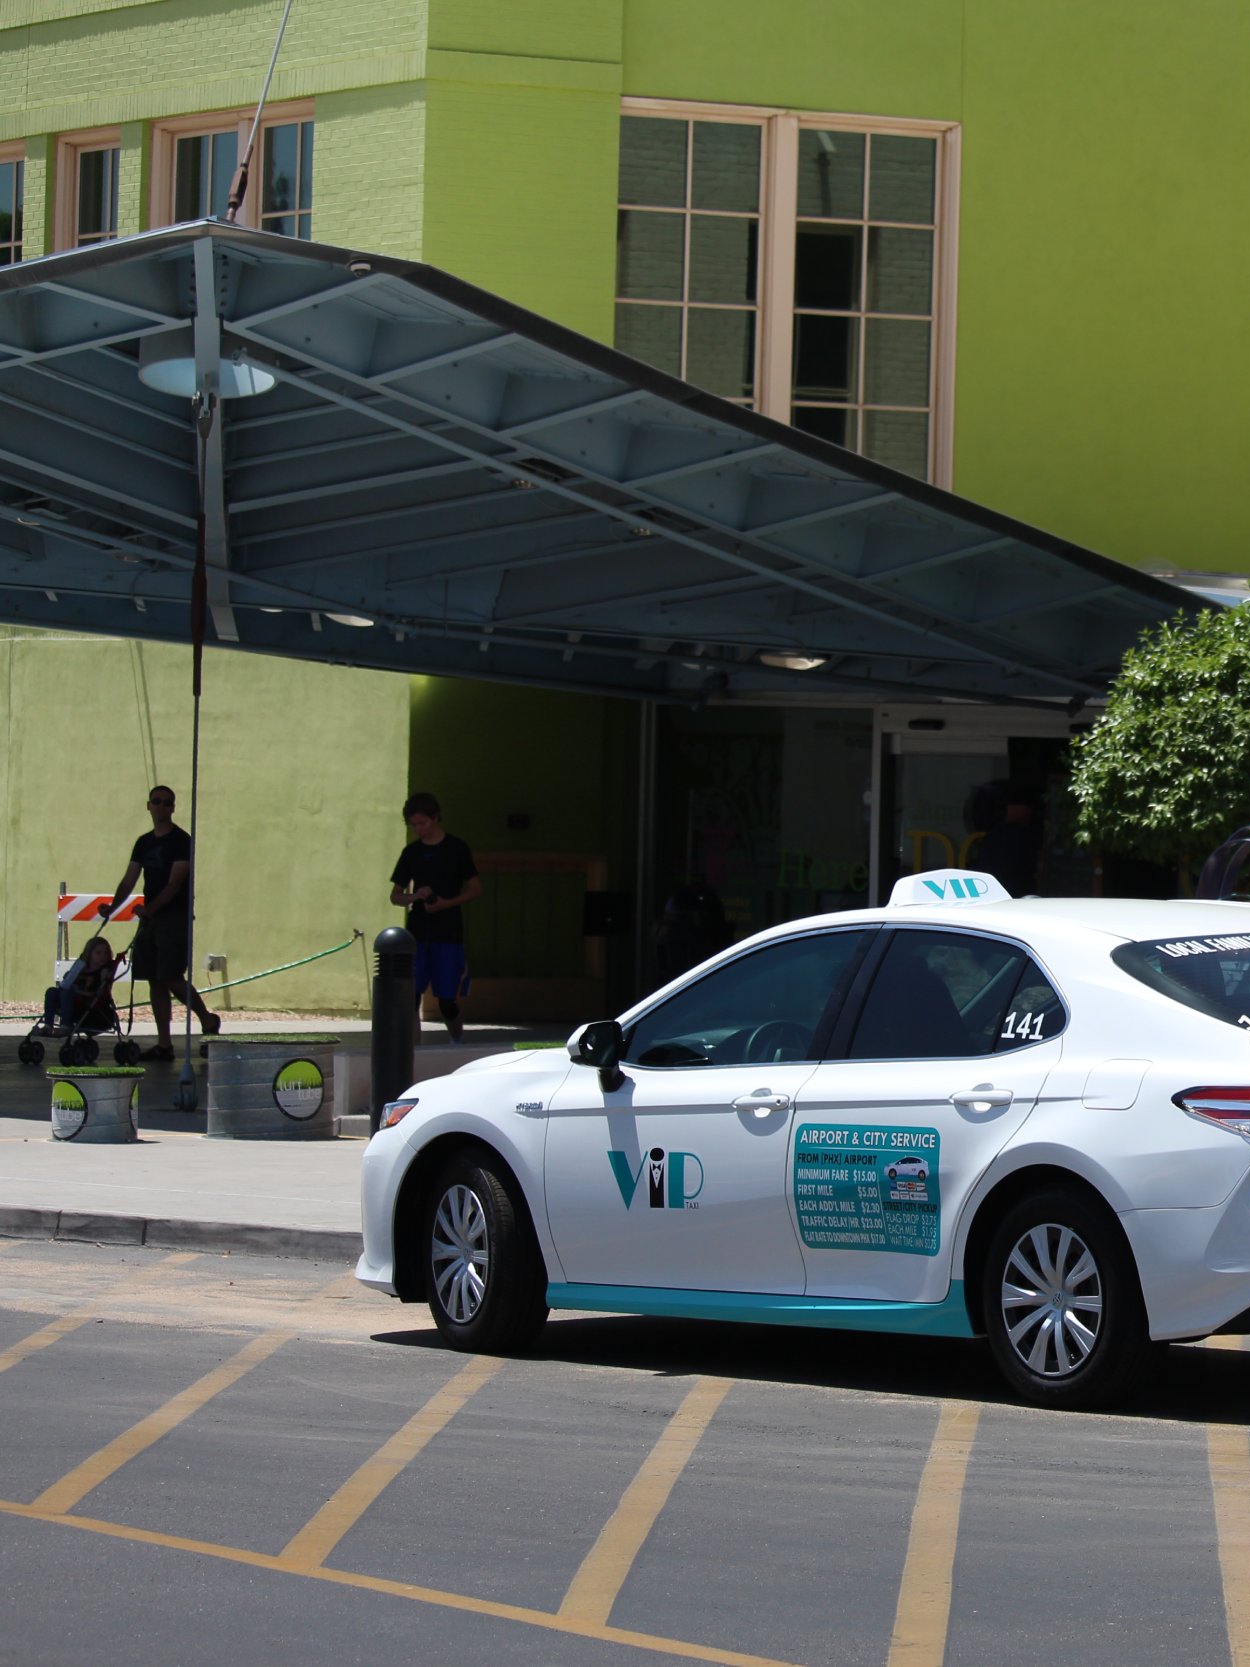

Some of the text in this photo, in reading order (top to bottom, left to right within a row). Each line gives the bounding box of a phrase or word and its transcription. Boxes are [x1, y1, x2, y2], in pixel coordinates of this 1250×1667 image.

[921, 878, 989, 900] VIP
[1156, 940, 1219, 958] LOCAL
[1000, 1011, 1045, 1040] 141
[800, 1130, 936, 1148] AIRPORT & CITY SERVICE
[797, 1152, 878, 1166] FROM [PHX] AIRPORT
[797, 1168, 877, 1183] MINIMUM FARE $15.00
[797, 1184, 816, 1196] FIRST
[817, 1184, 834, 1196] MILE
[857, 1186, 878, 1199] $5.00
[799, 1200, 880, 1215] EACH ADD'L MILE $2.30
[801, 1215, 828, 1227] TRAFFIC
[861, 1217, 883, 1230] $23.00
[885, 1212, 902, 1223] FLAG
[903, 1213, 919, 1224] DROP
[888, 1224, 904, 1234] EACH
[905, 1225, 917, 1236] MILE
